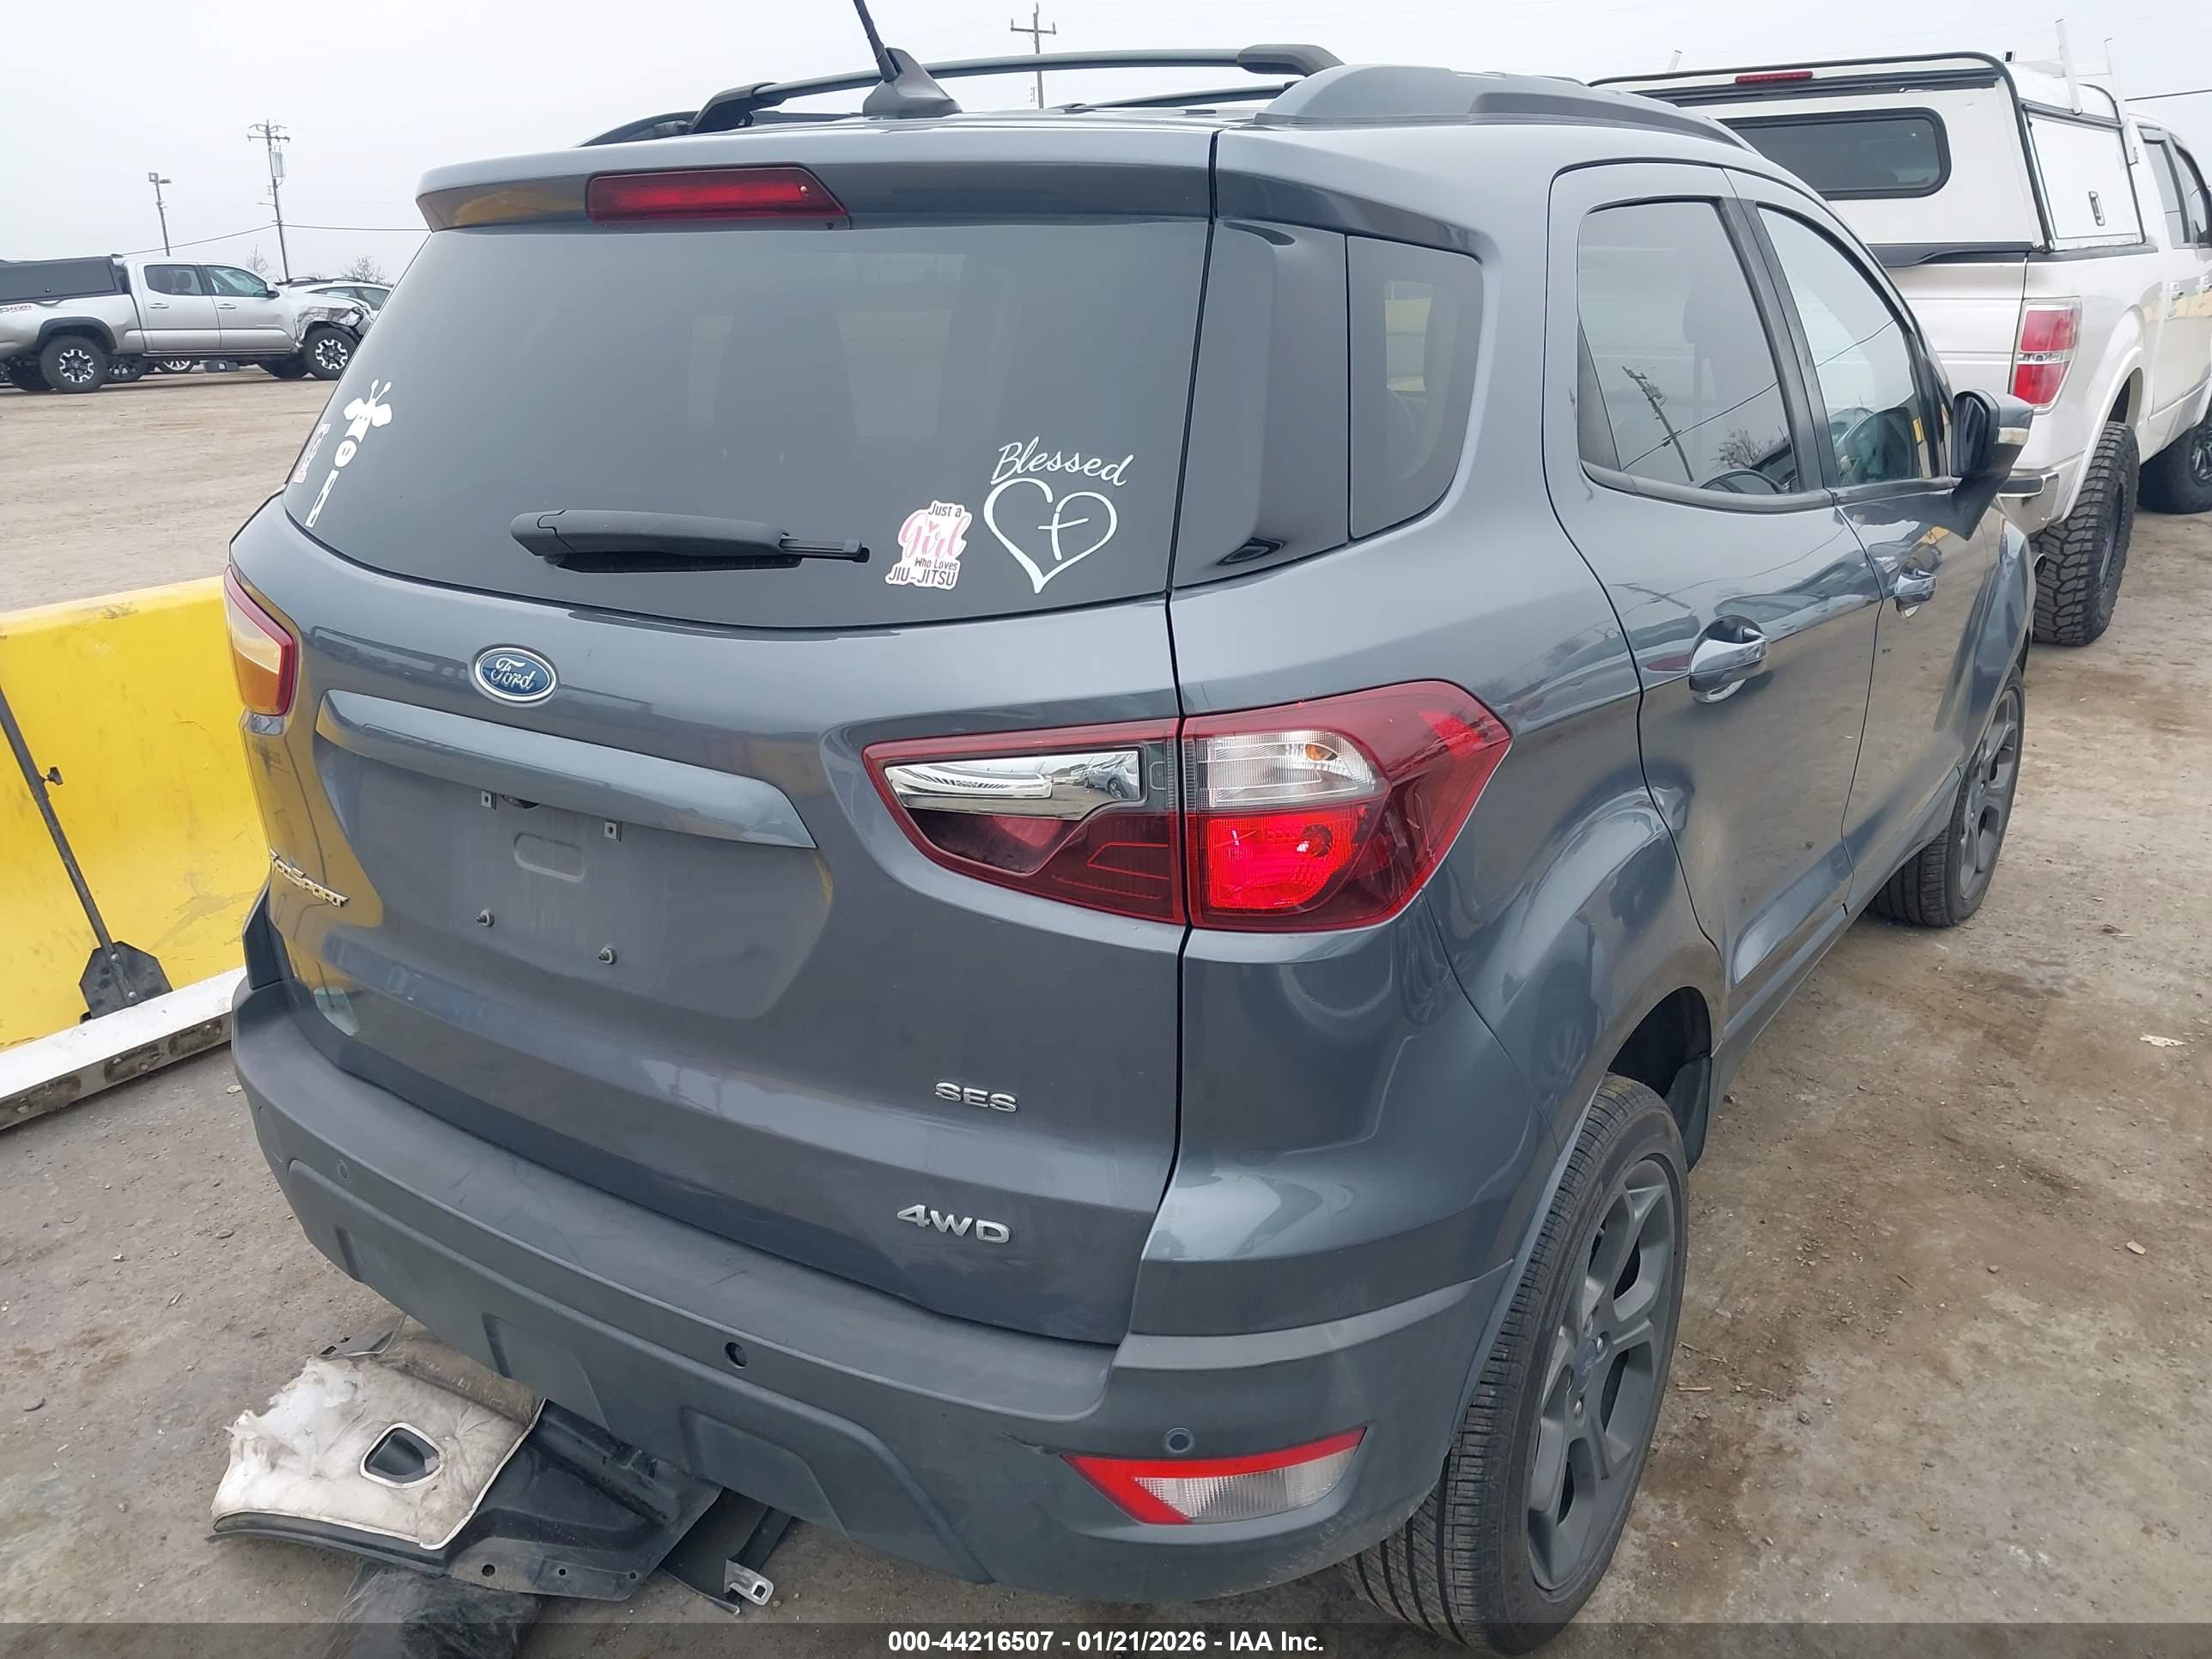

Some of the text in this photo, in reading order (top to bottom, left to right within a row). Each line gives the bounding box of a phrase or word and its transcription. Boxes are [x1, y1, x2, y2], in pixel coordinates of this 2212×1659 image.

[990, 435, 1134, 486] Blessed
[927, 503, 962, 518] Just a
[901, 513, 969, 558] Girl
[889, 566, 956, 586] JIU-JITSU
[915, 557, 958, 571] Who Loves
[490, 658, 537, 690] Ford
[935, 1082, 1018, 1113] SES
[896, 1203, 1011, 1243] 4WD
